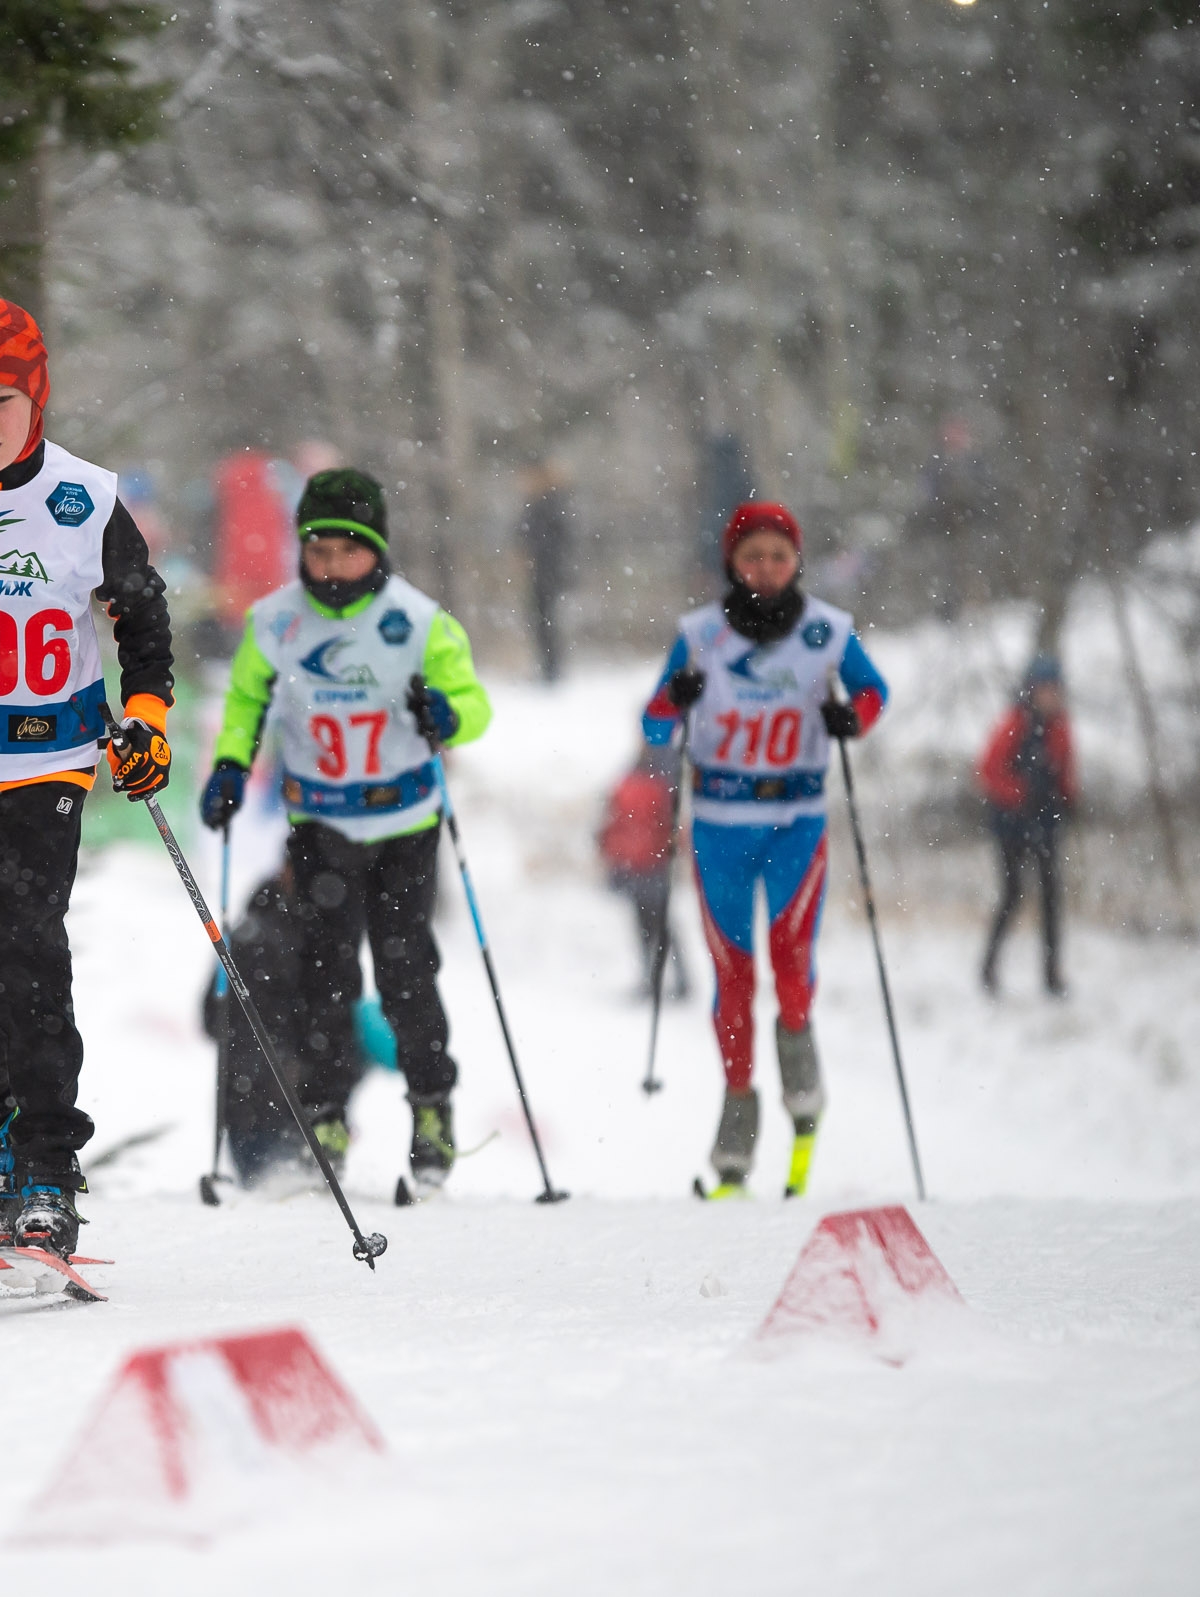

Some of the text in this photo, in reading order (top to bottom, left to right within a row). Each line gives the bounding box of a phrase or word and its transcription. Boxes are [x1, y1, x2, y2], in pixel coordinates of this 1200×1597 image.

[16, 717, 50, 736] Макс
[309, 708, 388, 780] 97
[714, 706, 803, 767] 110
[117, 751, 143, 779] COXA
